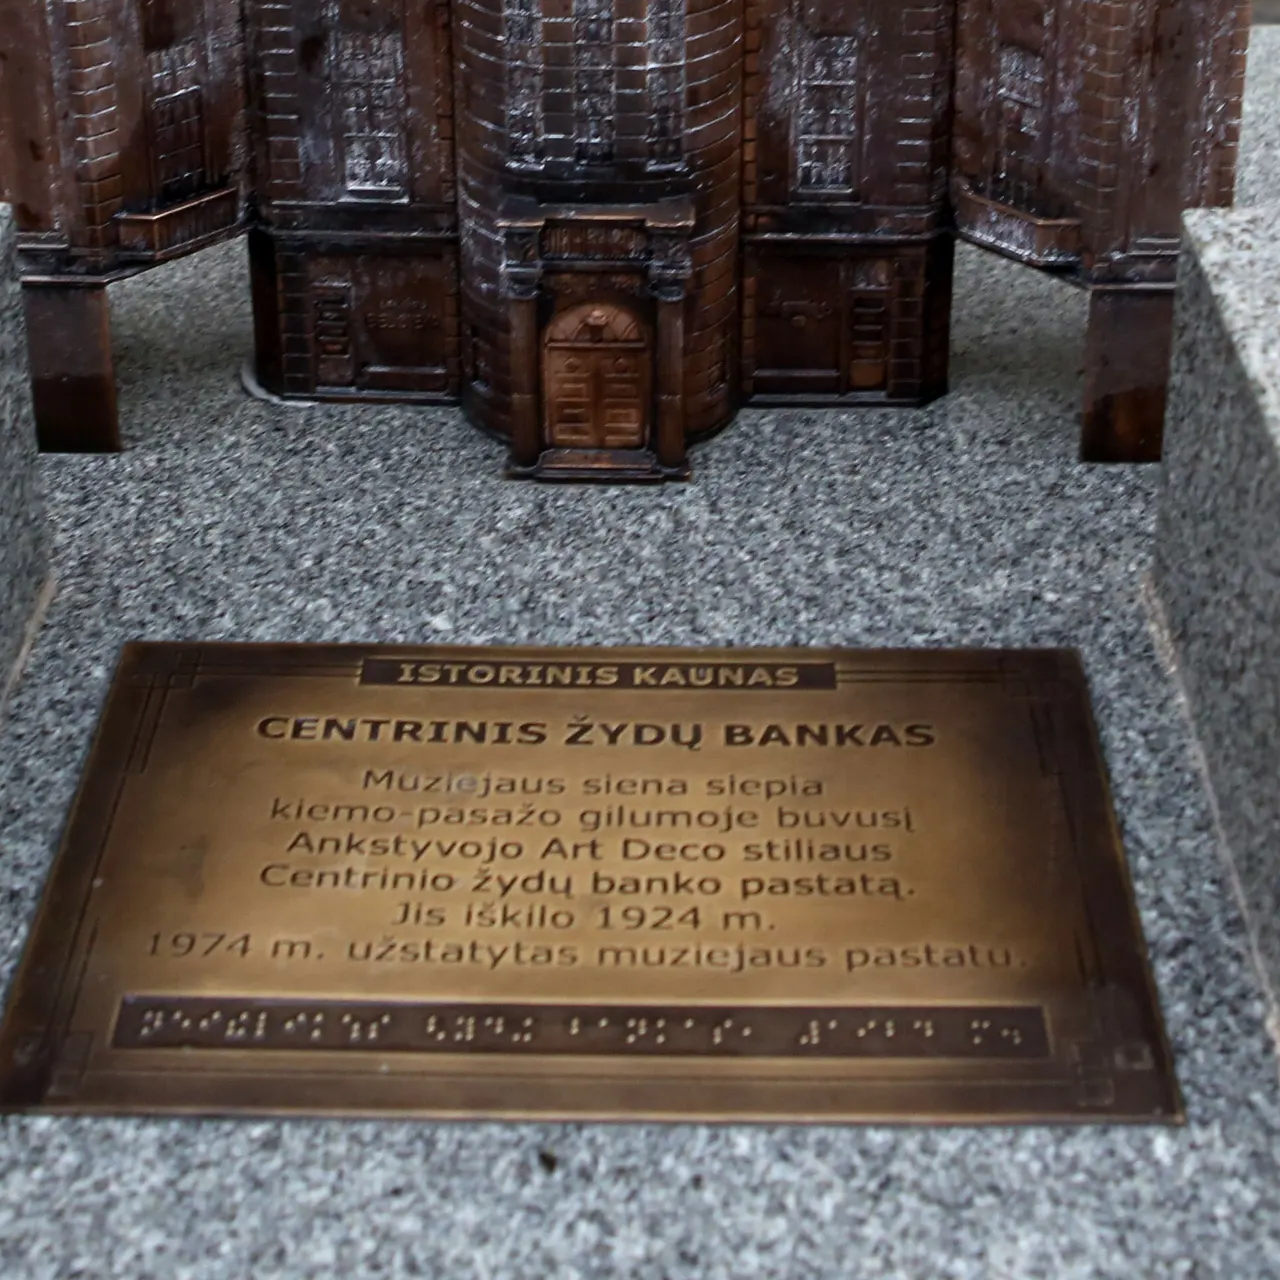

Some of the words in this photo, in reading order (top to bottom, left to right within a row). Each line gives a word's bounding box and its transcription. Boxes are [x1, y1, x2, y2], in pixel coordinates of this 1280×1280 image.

[397, 663, 619, 686] ISTORINIS
[632, 667, 800, 687] KAUNAS
[257, 717, 548, 745] CENTRINIS
[564, 714, 703, 751] ŽYDŲ
[724, 723, 935, 748] BANKAS
[362, 770, 565, 798] Muziejaus
[582, 773, 689, 796] siena
[270, 798, 561, 829] kiemo-pasažo
[579, 804, 760, 832] gilumoje
[777, 805, 916, 832] buvusį
[285, 831, 524, 863] Ankstyvojo
[540, 836, 604, 860] Art
[622, 838, 725, 861] Deco
[742, 839, 892, 863] stiliaus
[259, 864, 456, 892] Centrinio
[472, 867, 573, 899] žydų
[592, 871, 721, 895] banko
[740, 874, 916, 900] pastatą.
[391, 902, 446, 927] Jis
[464, 904, 575, 930] iškilo
[597, 905, 701, 931] 1924
[721, 909, 776, 931] m.
[147, 931, 252, 959] 1974
[270, 938, 325, 961] m.
[348, 936, 578, 970] užstatytas
[598, 942, 826, 972] muziejaus
